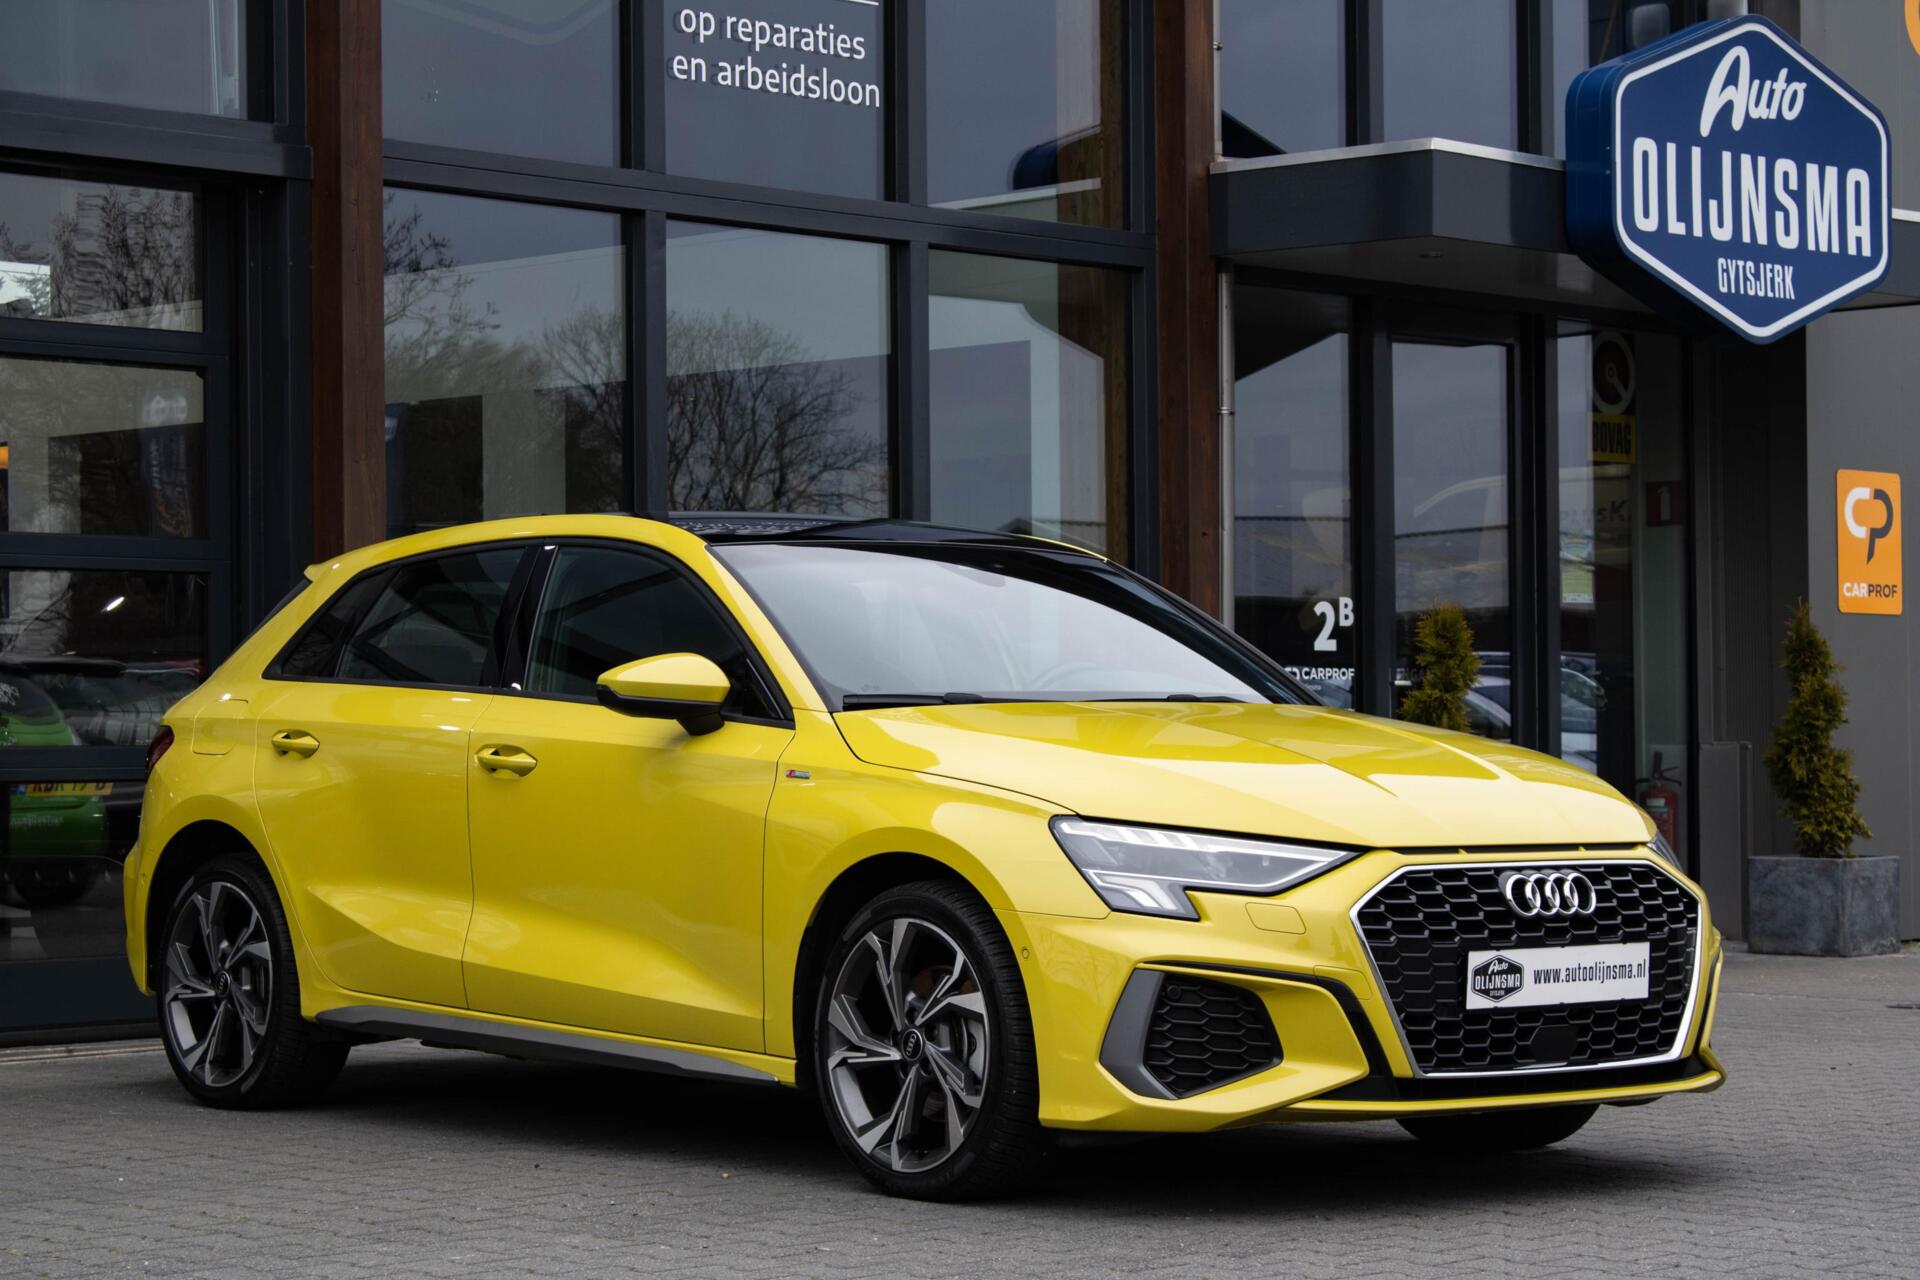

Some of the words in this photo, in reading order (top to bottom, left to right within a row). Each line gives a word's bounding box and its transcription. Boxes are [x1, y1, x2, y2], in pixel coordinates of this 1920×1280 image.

[680, 8, 715, 43] op
[726, 15, 865, 60] reparaties
[672, 54, 707, 82] en
[717, 55, 880, 108] arbeidsloon
[1700, 45, 1807, 138] Auto
[1632, 136, 1872, 258] OLIJNSMA
[1717, 257, 1795, 300] GYTSJERK
[1843, 582, 1898, 598] CARPROF
[1301, 667, 1355, 681] CARPROF
[1474, 973, 1521, 990] OLIJNSMA
[1487, 959, 1509, 975] Auto
[1533, 958, 1646, 985] www.autoolijnsma.nl
